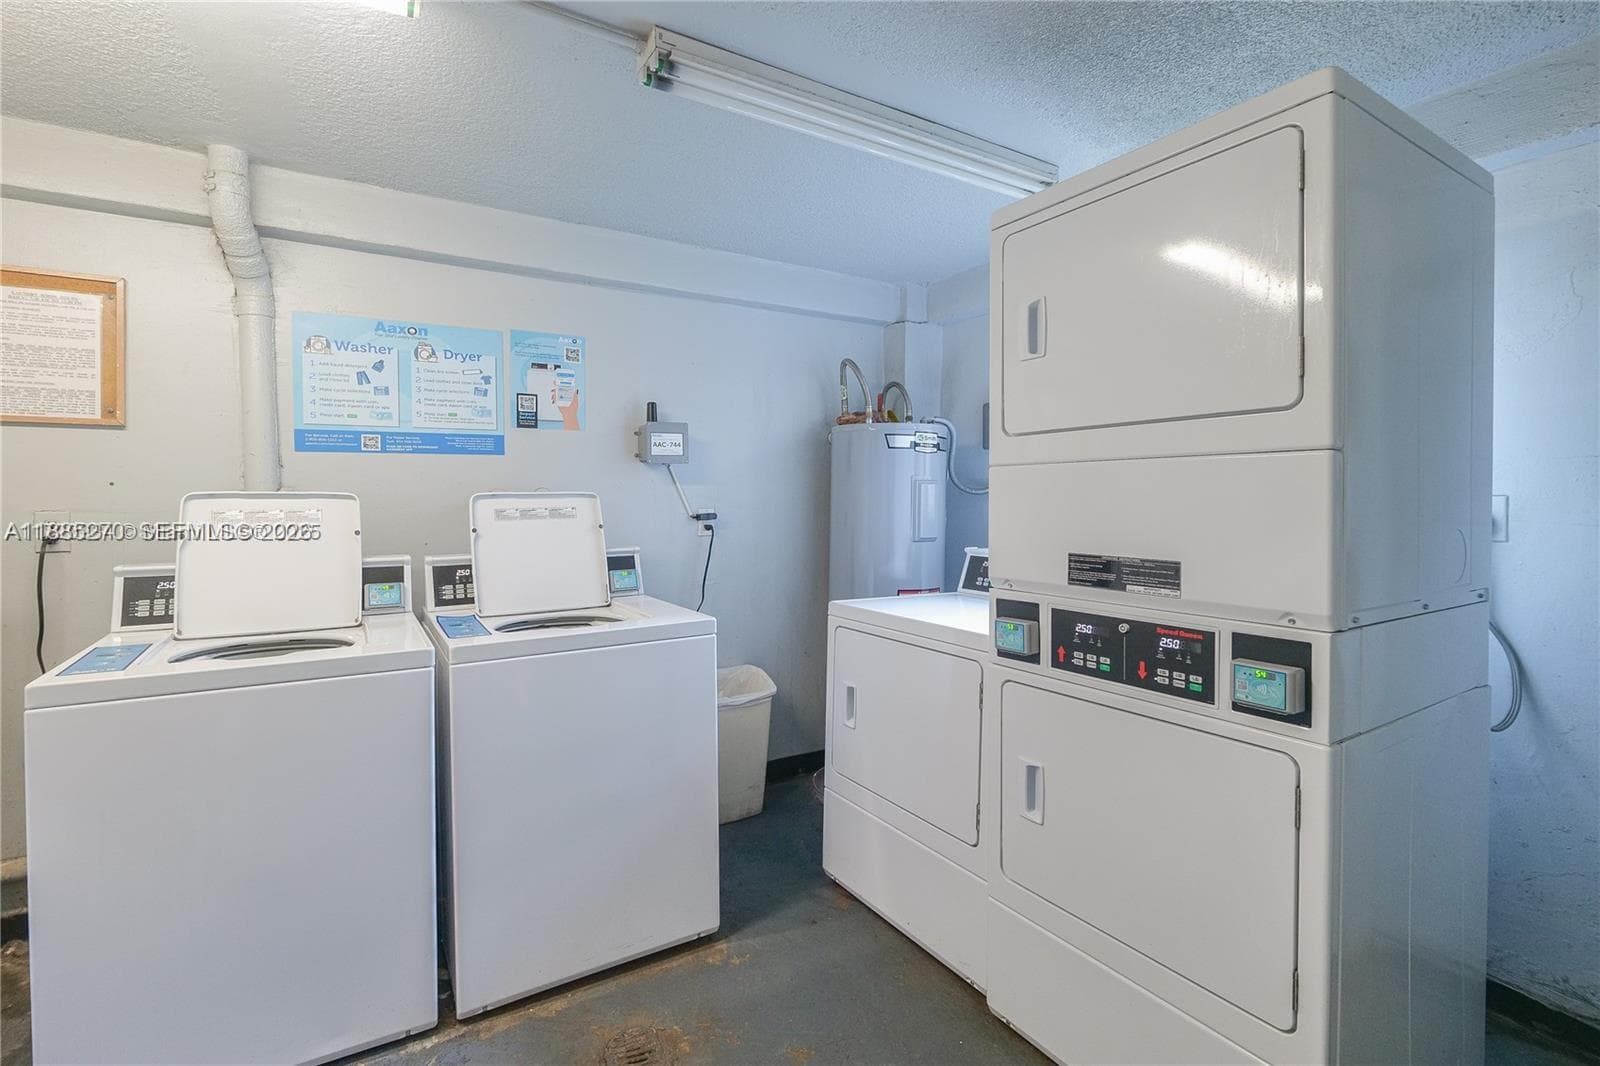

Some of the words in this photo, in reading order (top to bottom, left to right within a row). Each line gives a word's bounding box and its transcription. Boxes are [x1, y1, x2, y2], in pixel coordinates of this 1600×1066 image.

[375, 321, 428, 336] Aaxon
[334, 340, 394, 354] Washer
[443, 349, 482, 363] Dryer
